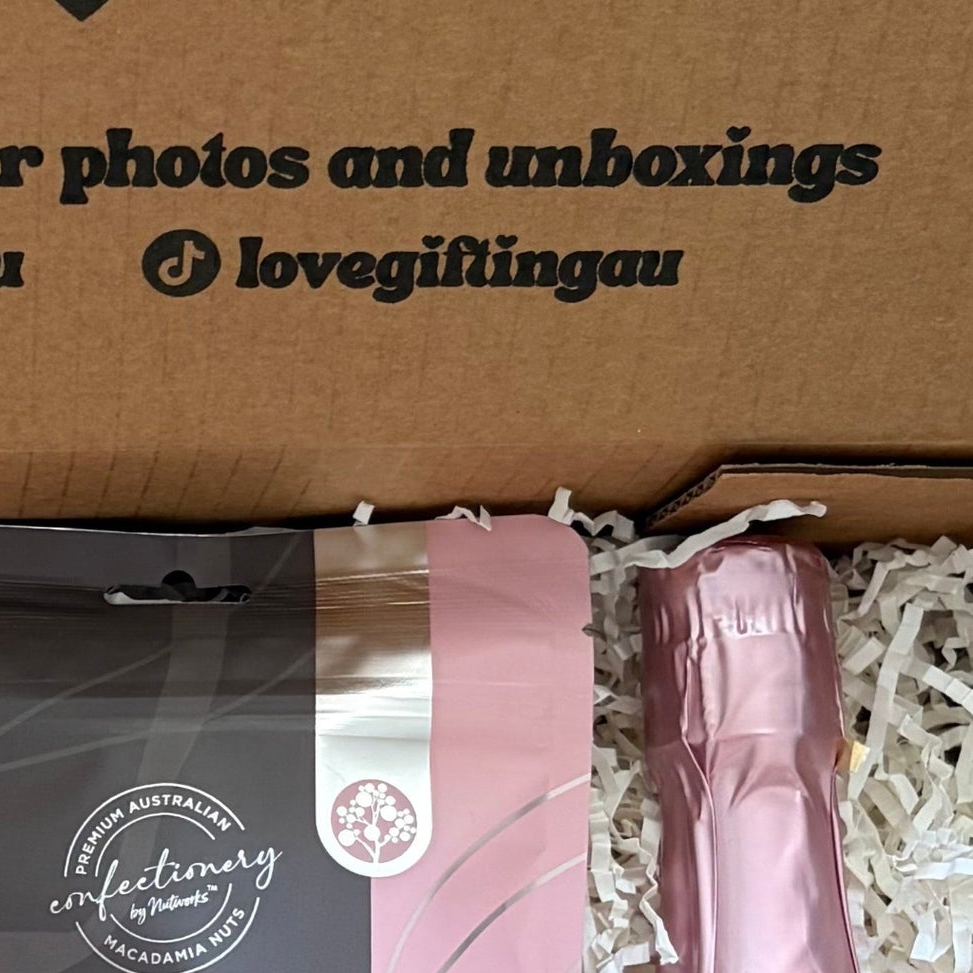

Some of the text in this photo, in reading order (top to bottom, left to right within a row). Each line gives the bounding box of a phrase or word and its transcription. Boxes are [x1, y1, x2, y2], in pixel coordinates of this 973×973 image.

[60, 128, 309, 204] photos
[328, 128, 475, 188] and
[485, 126, 882, 203] unboxings
[236, 235, 684, 303] lovegiftingau
[75, 794, 232, 875] PREMIUM AUSTRALIAN
[49, 847, 283, 922] confectionery
[129, 903, 146, 925] by
[104, 907, 246, 965] MACADAMIA NUTS
